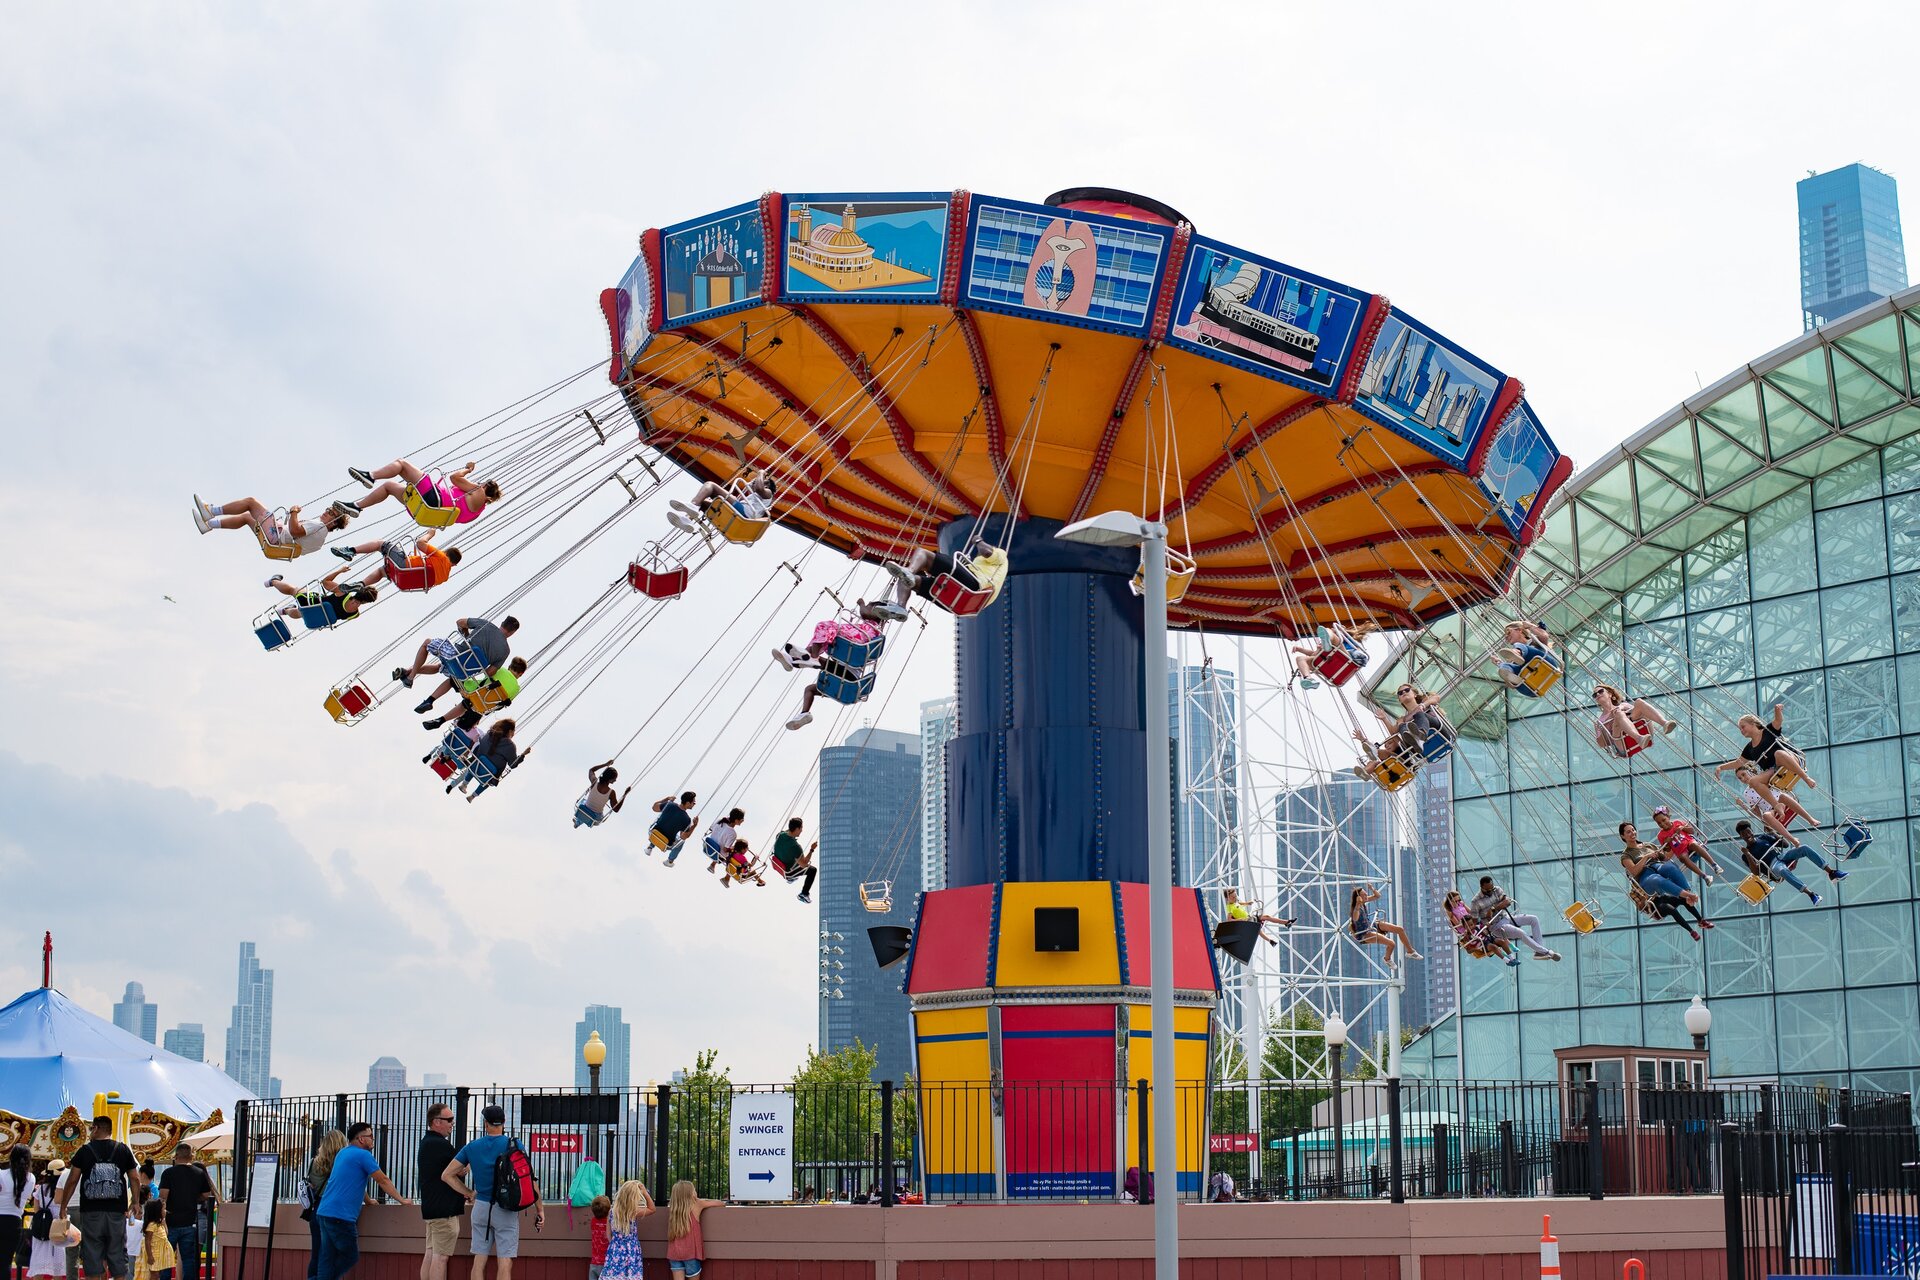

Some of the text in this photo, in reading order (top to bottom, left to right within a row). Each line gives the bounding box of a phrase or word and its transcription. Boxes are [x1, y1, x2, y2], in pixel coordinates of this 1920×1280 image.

[748, 1112, 776, 1121] WAVE
[739, 1125, 784, 1134] SWINGER
[537, 1137, 558, 1148] EXT
[1211, 1138, 1230, 1148] XIT
[738, 1148, 786, 1156] ENTRANCE
